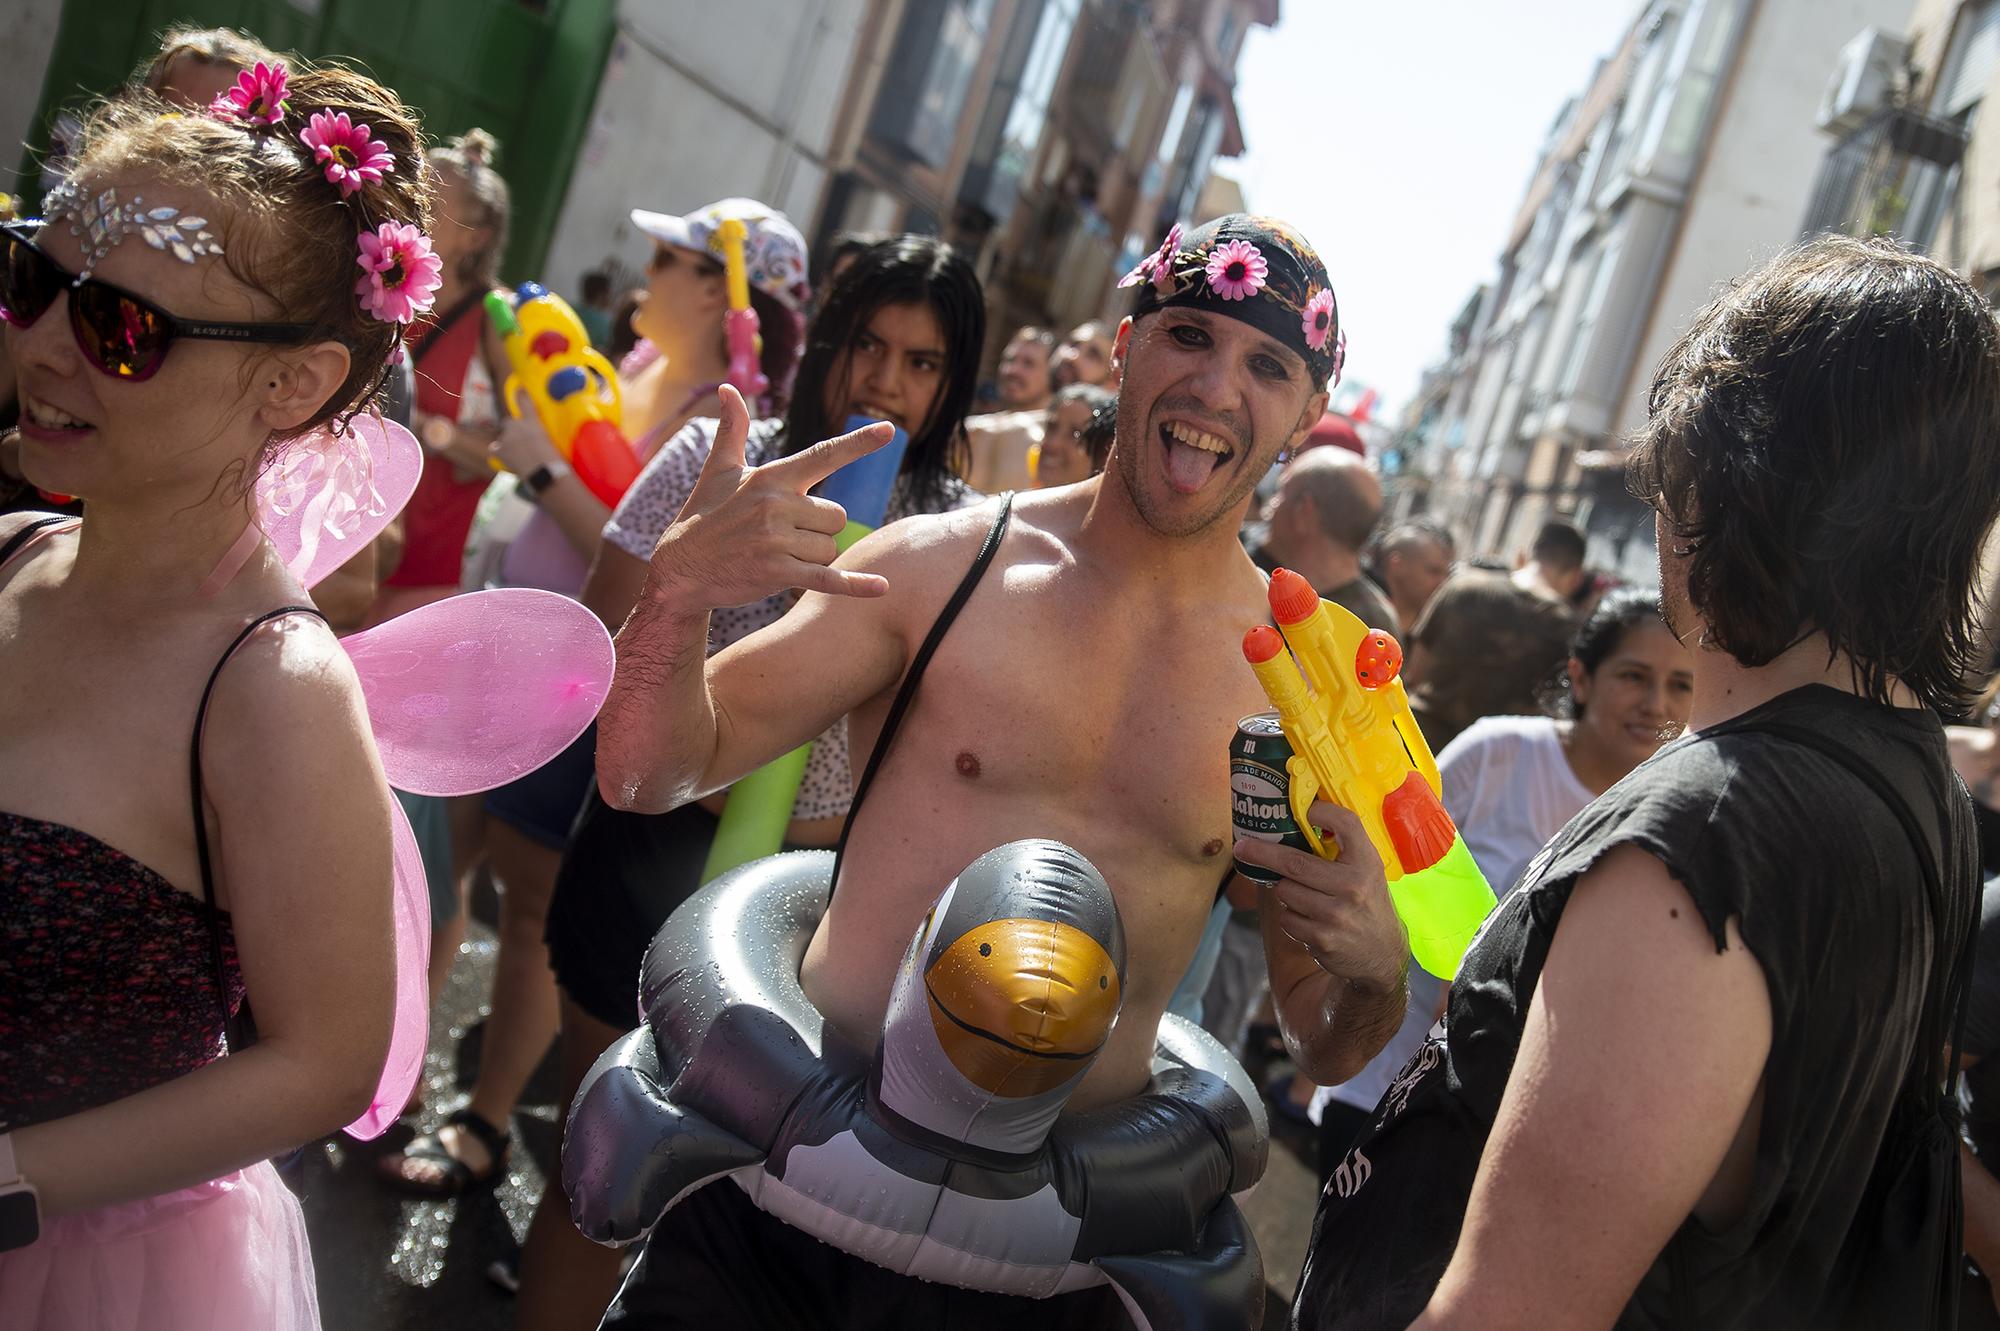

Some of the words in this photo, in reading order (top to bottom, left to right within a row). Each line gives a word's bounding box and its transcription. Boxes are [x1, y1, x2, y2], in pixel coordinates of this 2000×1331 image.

[1241, 781, 1257, 791] 1890
[1249, 767, 1260, 776] DE
[1260, 771, 1286, 790] MAHOU
